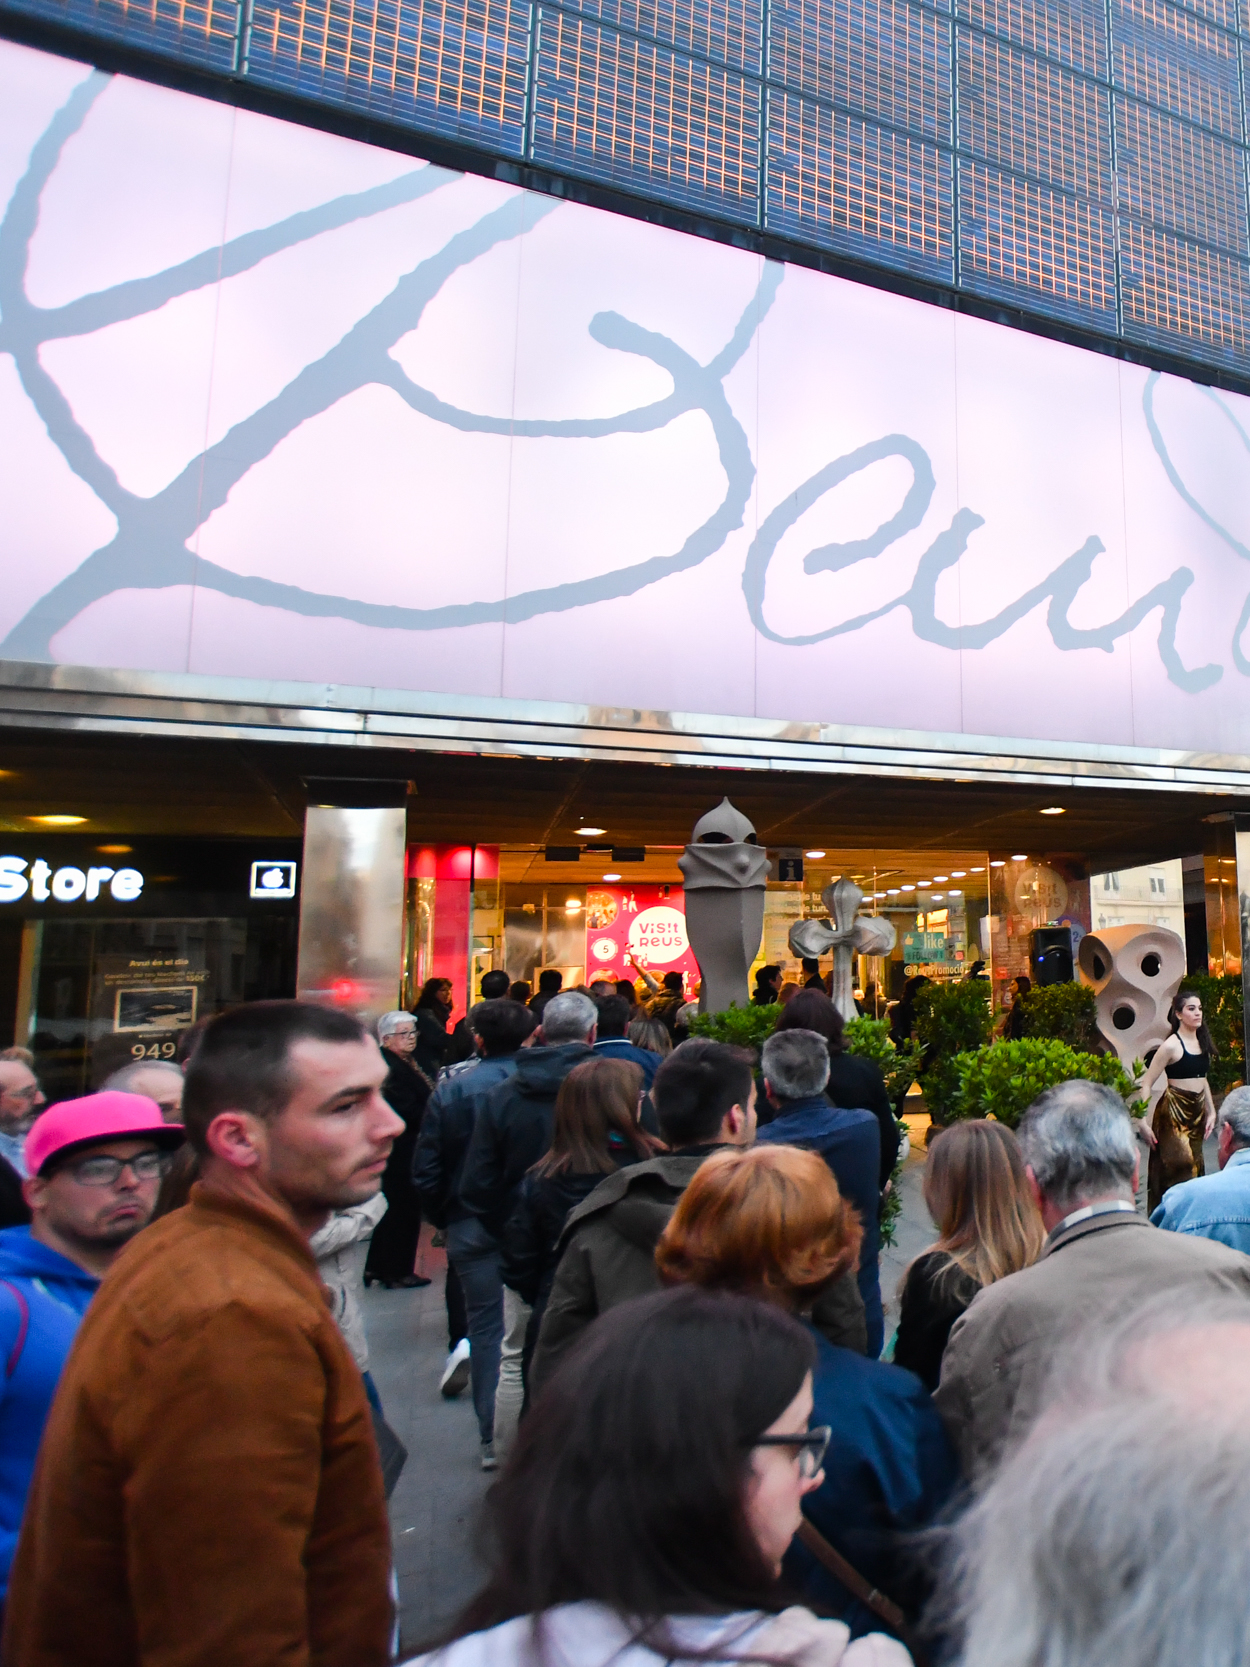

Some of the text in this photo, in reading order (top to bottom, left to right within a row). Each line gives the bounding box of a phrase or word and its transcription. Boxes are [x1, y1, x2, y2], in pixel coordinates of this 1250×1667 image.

[0, 855, 145, 903] Store
[602, 945, 609, 954] 5
[923, 933, 944, 949] like
[131, 1041, 177, 1061] 949
